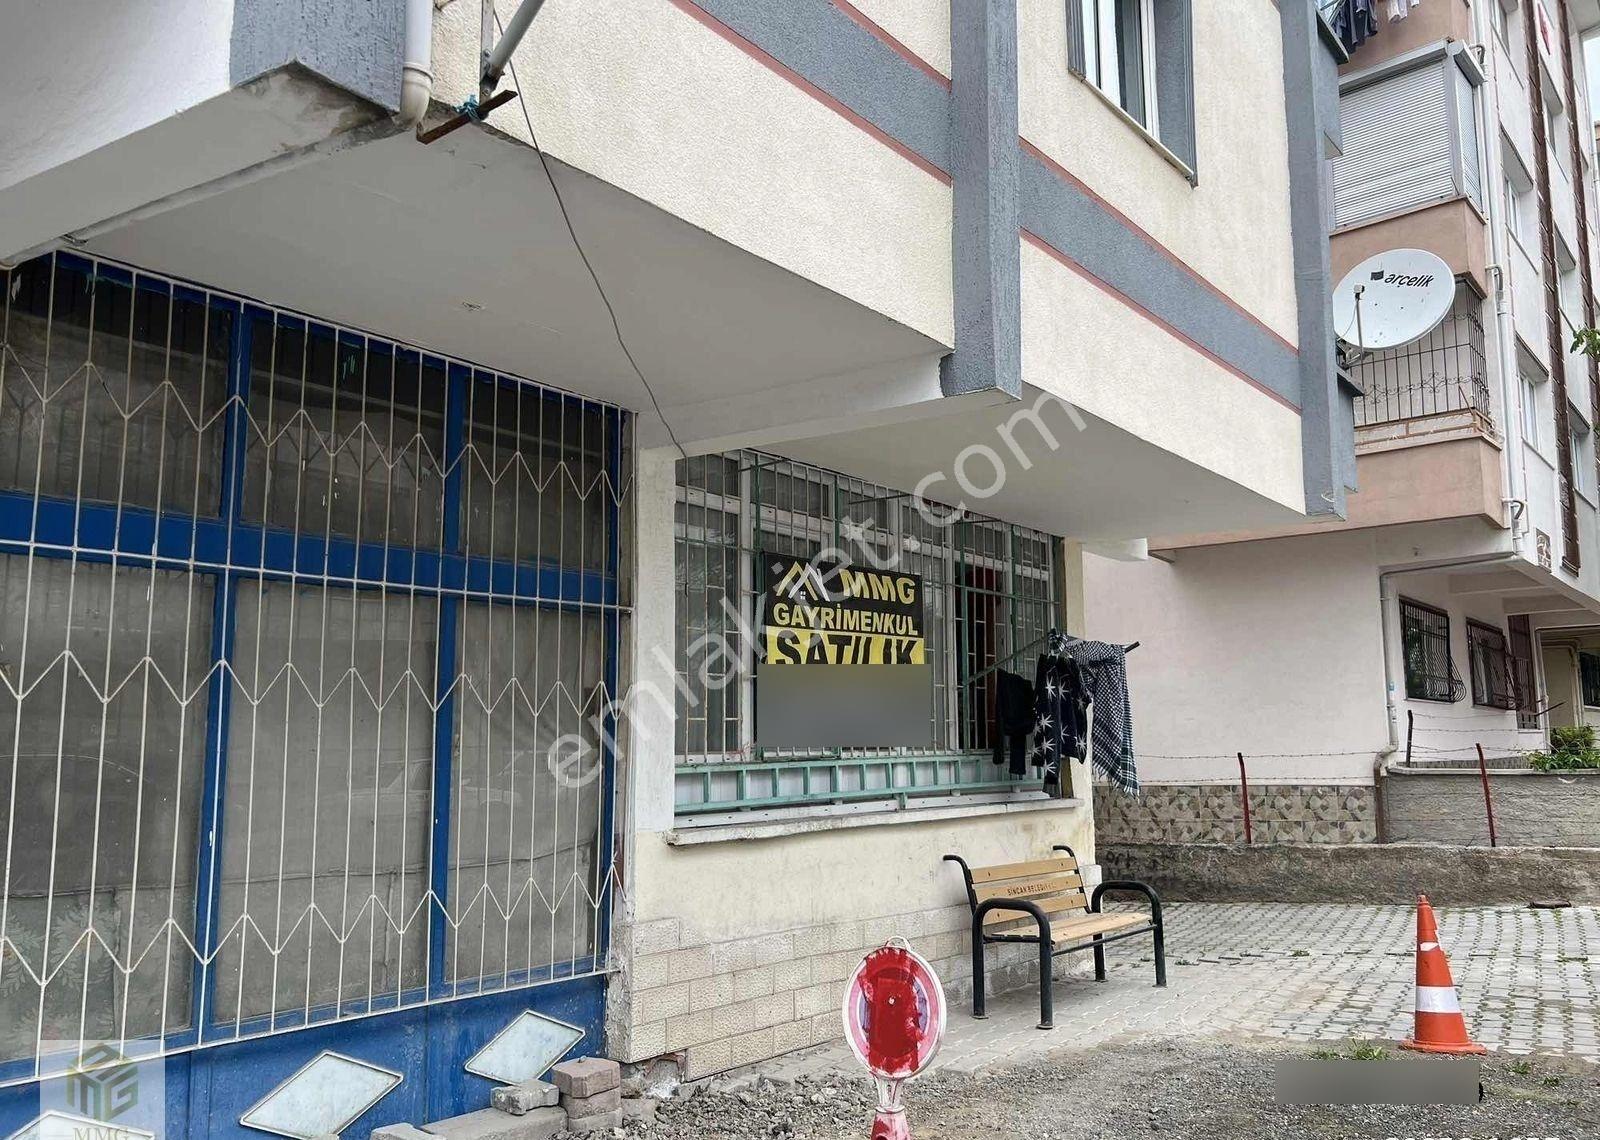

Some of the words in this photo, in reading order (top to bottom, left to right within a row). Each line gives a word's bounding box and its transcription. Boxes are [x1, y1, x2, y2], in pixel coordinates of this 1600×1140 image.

[1384, 273, 1434, 288] arçelik
[839, 568, 916, 604] MMG
[773, 602, 918, 636] GAYRİMENKUL
